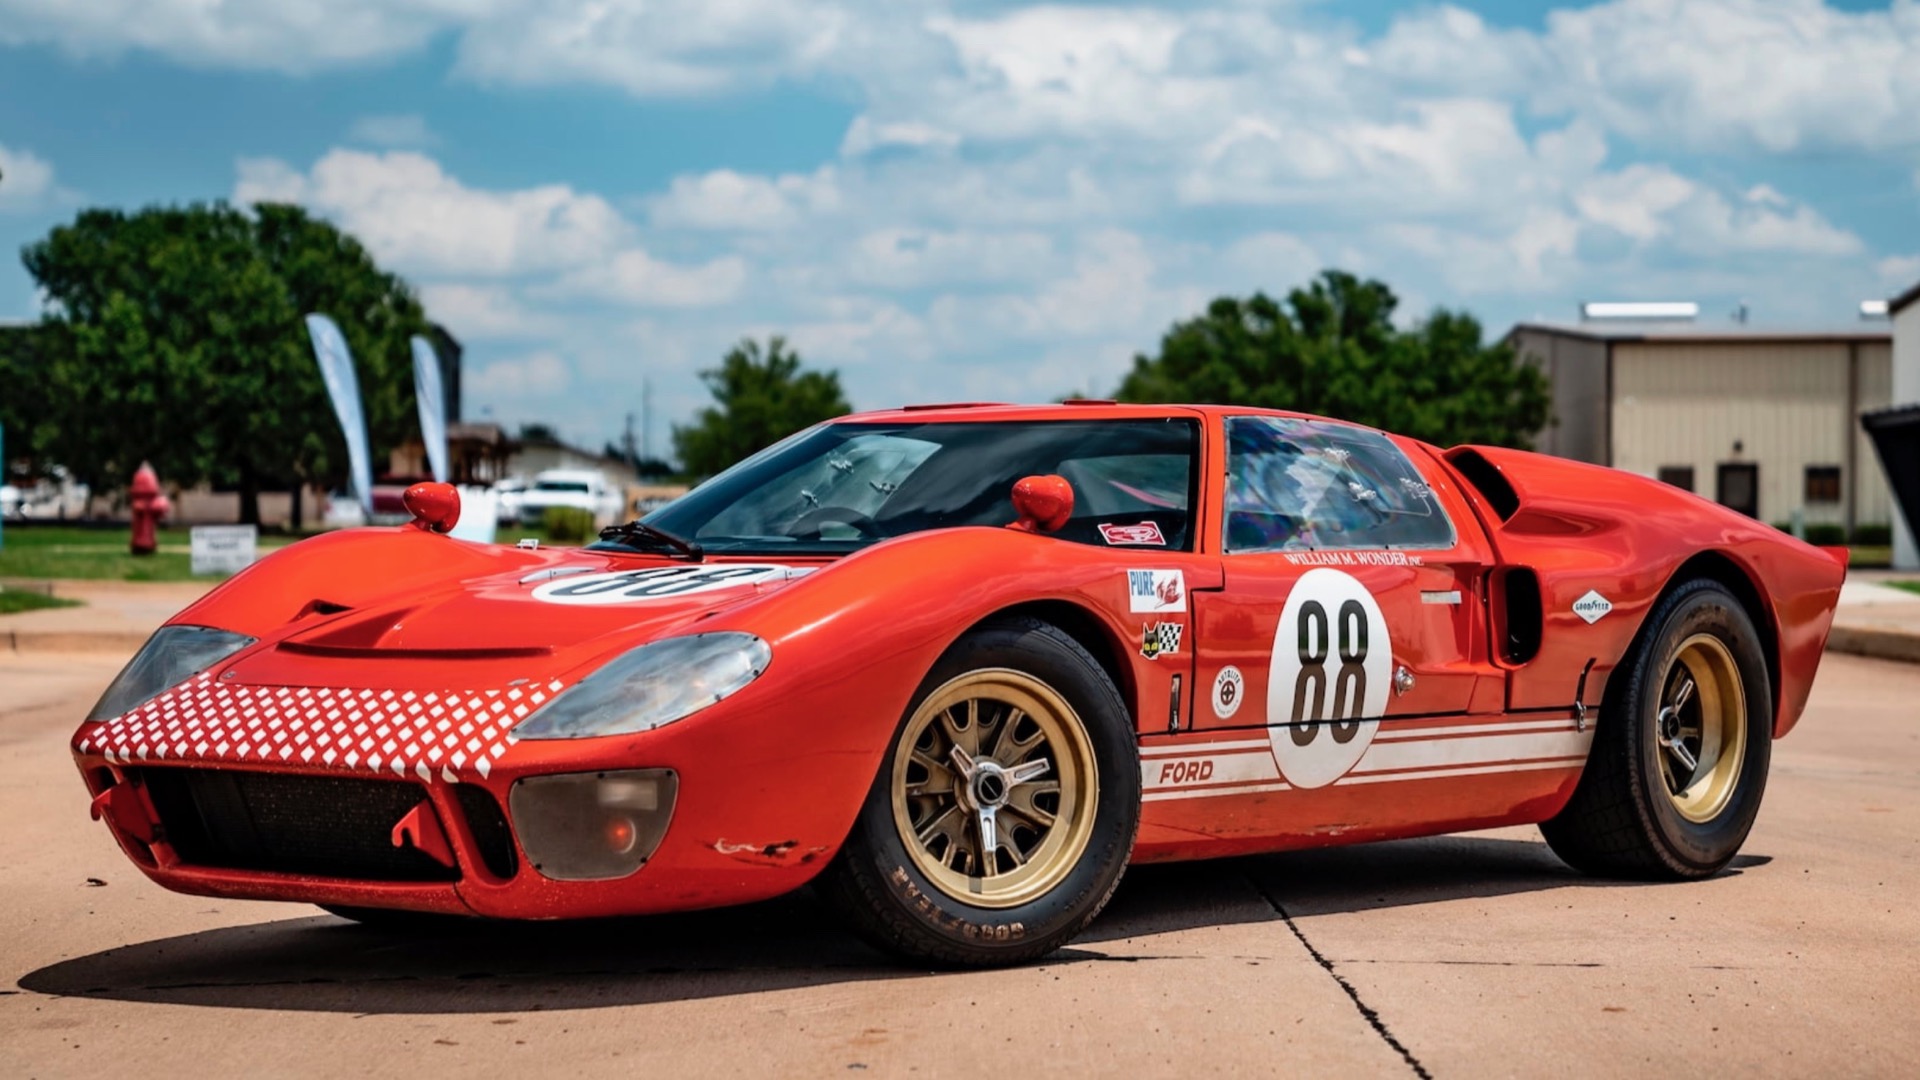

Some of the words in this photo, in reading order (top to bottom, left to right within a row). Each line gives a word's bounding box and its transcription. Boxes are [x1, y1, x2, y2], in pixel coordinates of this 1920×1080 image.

[1284, 552, 1342, 566] WILLIAM
[1340, 552, 1357, 566] M.
[1354, 552, 1409, 566] WONDER
[549, 567, 776, 597] 88
[1129, 571, 1155, 596] PURE
[1575, 600, 1609, 611] GOODYEAR
[1218, 669, 1241, 686] AUTOLITE
[1290, 599, 1369, 747] 88
[1159, 760, 1214, 784] FORD
